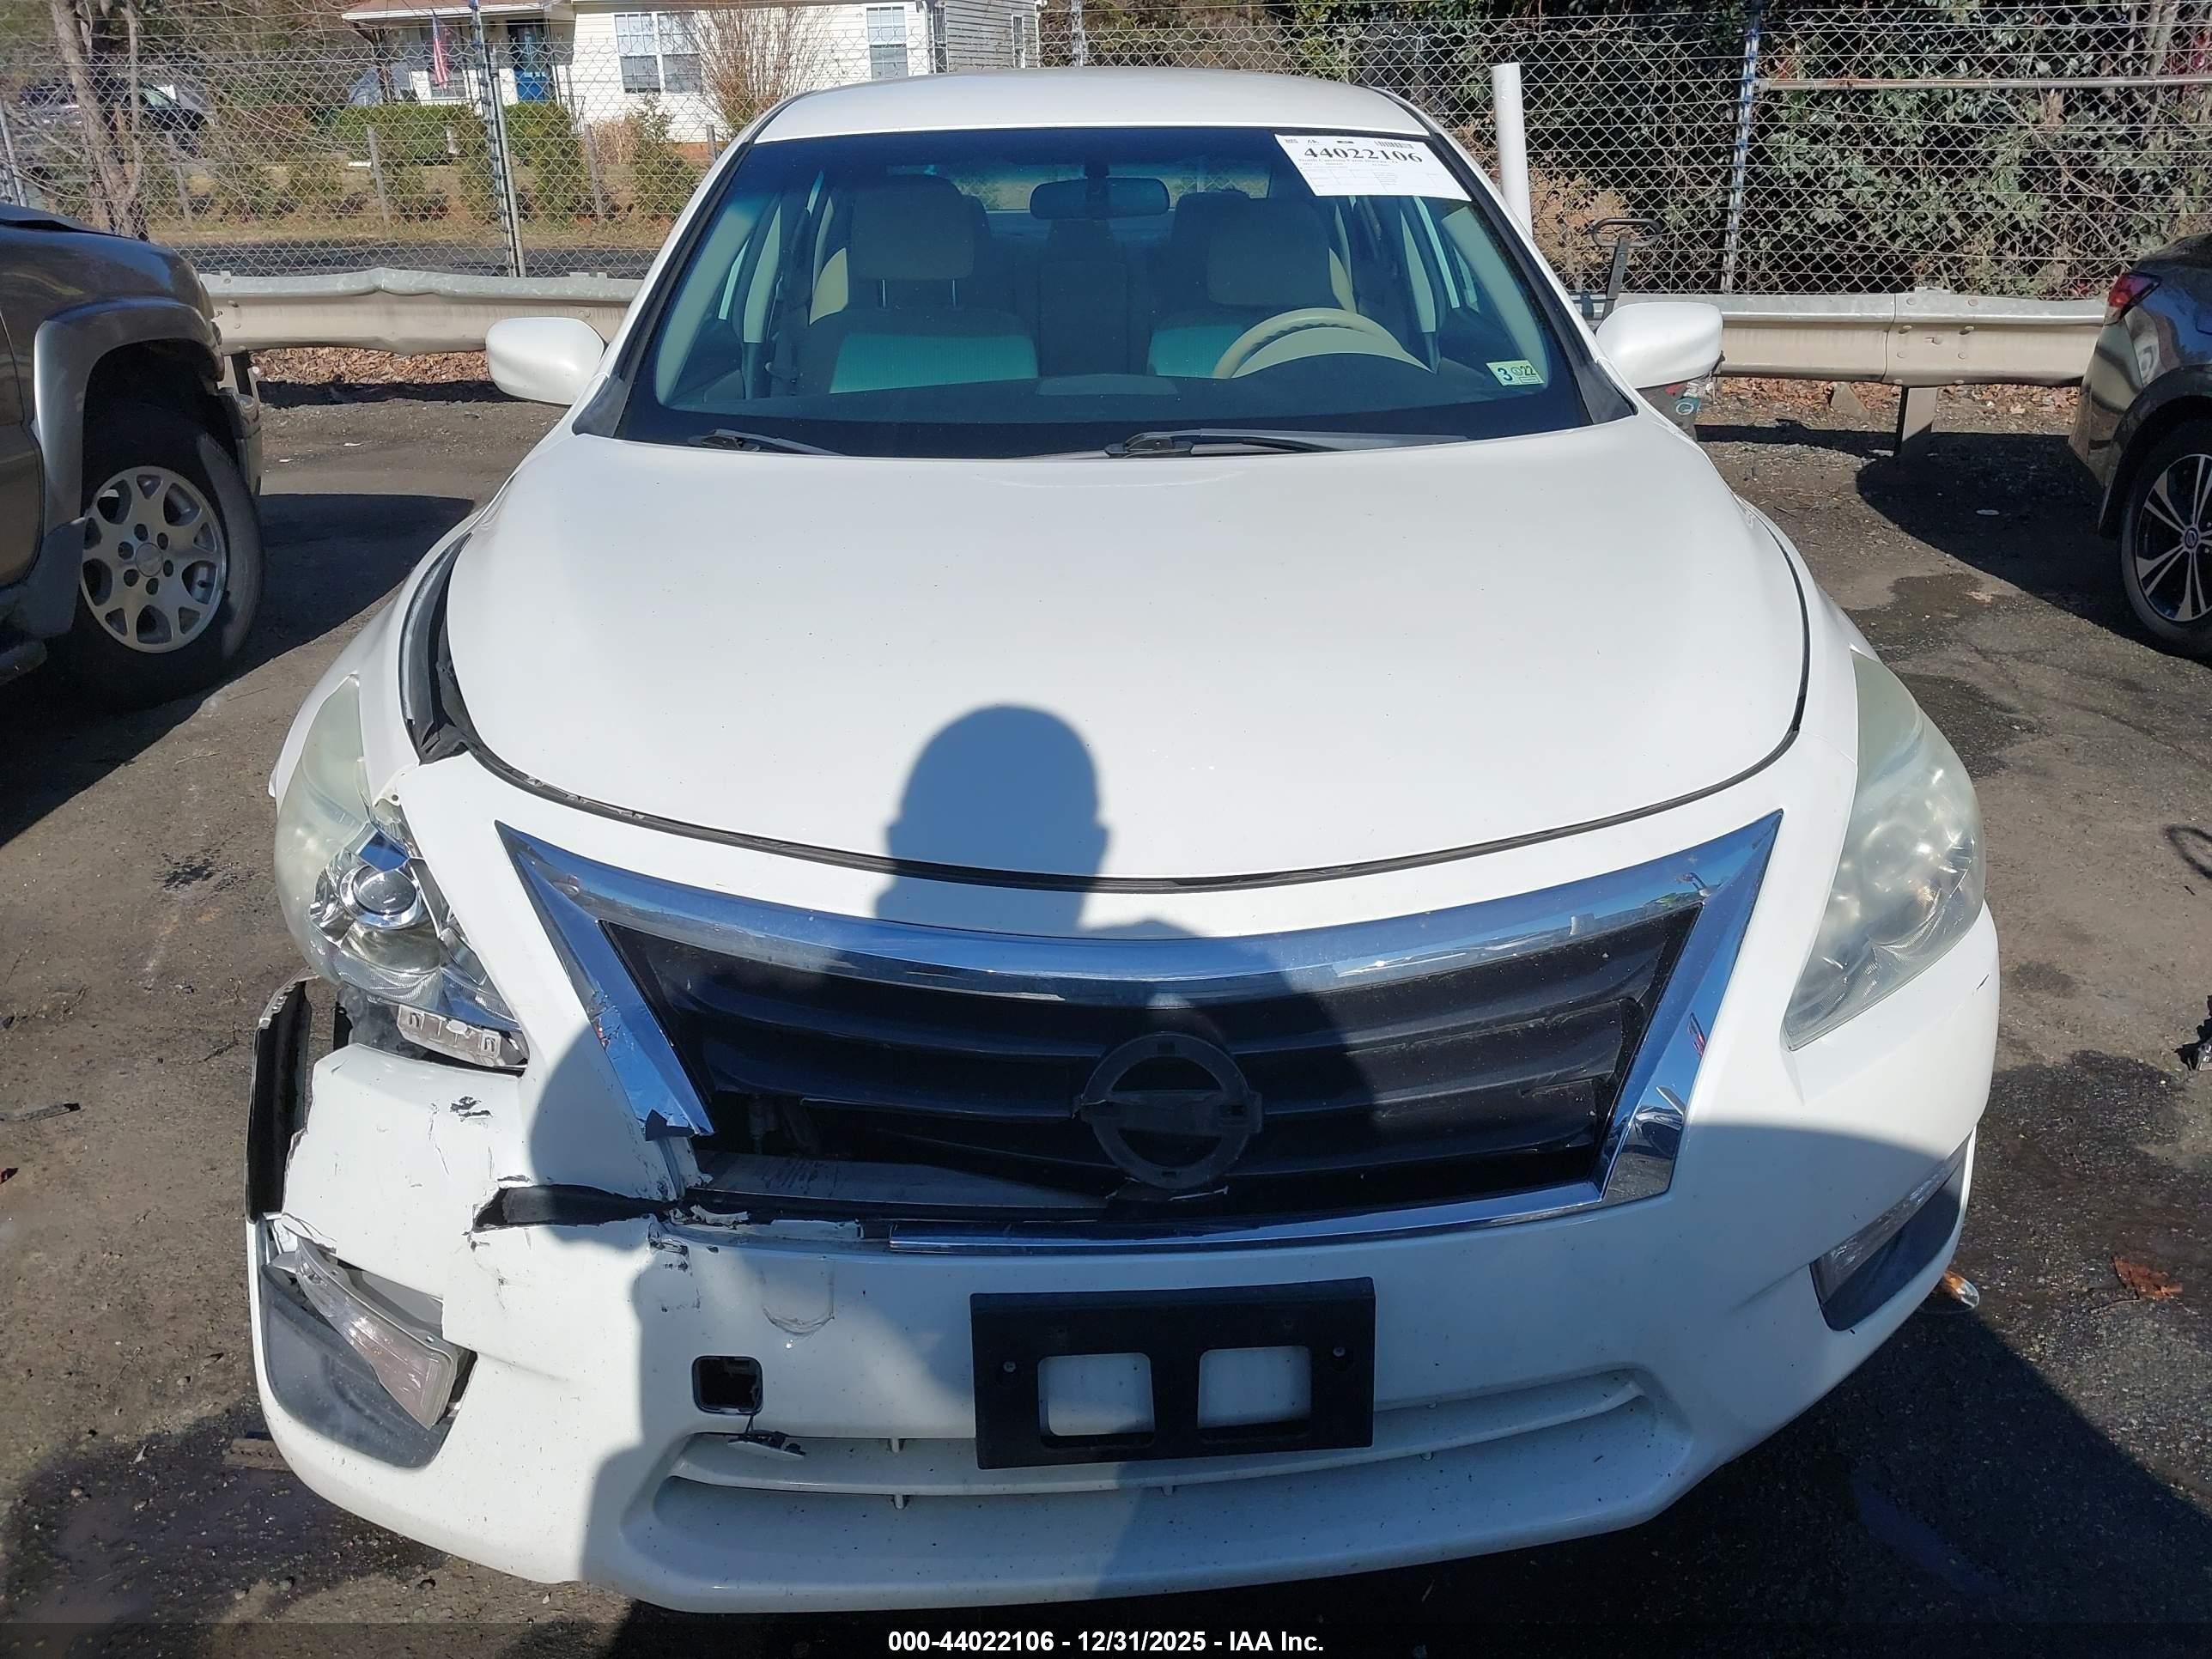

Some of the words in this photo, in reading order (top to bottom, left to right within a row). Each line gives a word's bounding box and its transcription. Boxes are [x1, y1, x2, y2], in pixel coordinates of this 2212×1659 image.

[1304, 147, 1423, 163] 44022106
[1497, 368, 1513, 380] 3
[1520, 365, 1537, 376] 22
